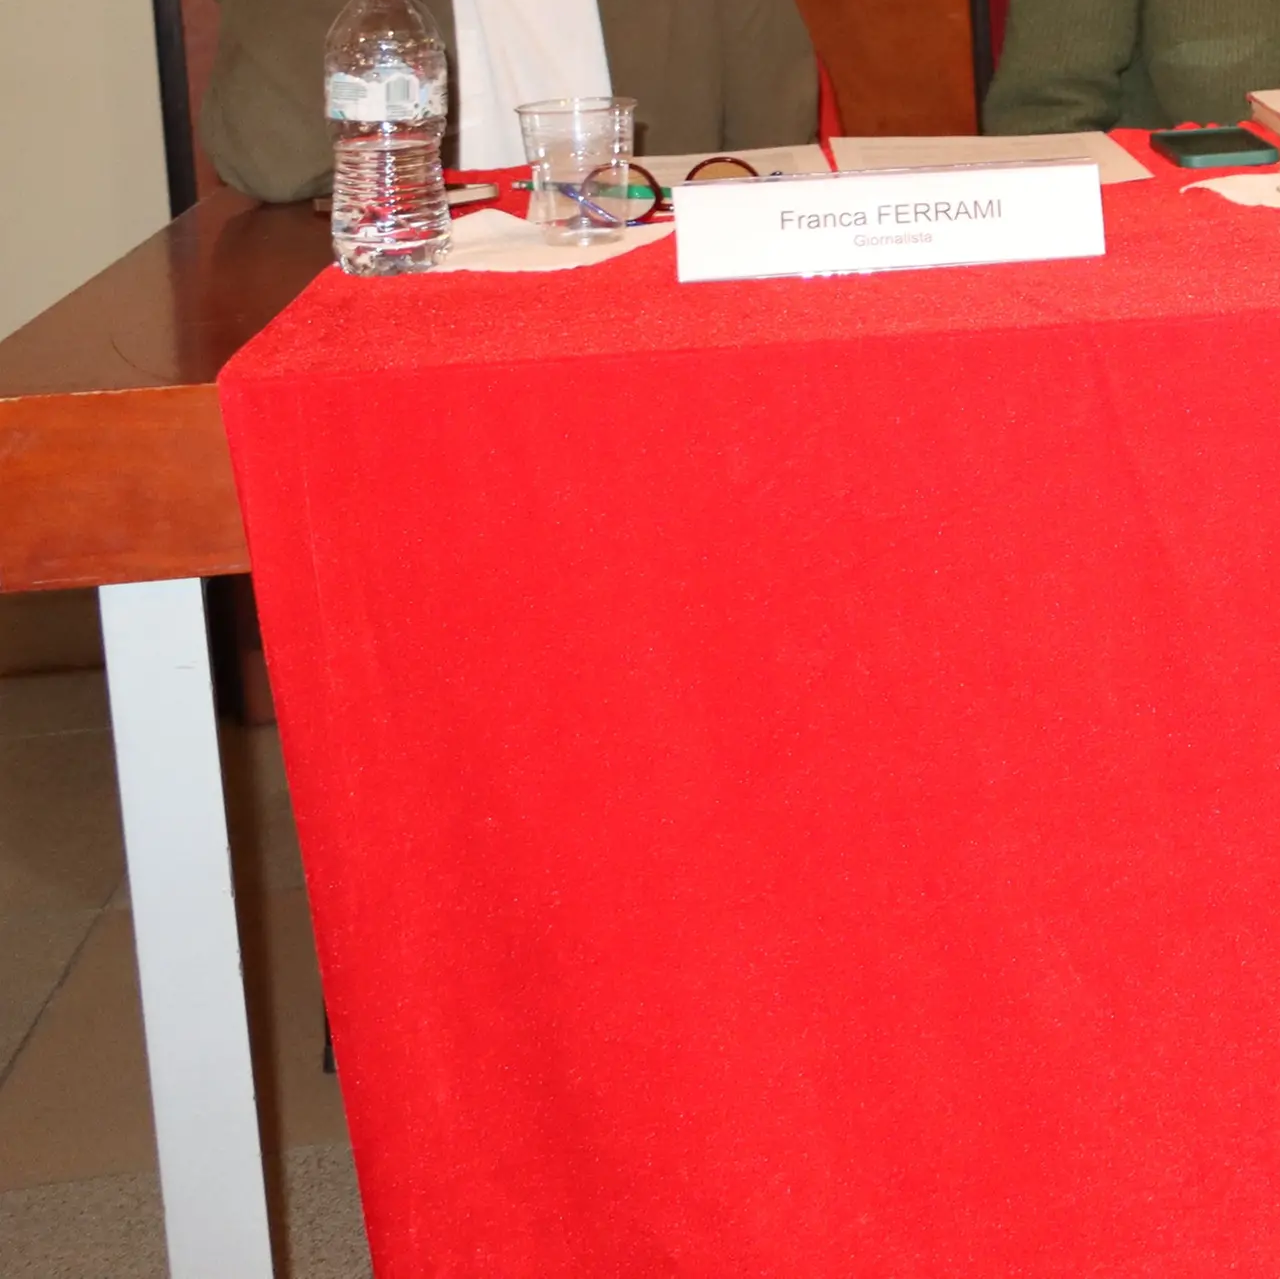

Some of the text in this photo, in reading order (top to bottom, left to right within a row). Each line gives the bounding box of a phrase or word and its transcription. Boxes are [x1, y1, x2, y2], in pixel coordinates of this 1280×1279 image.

[780, 199, 1002, 231] Franca FERRAMI
[853, 231, 933, 248] Giornalista
